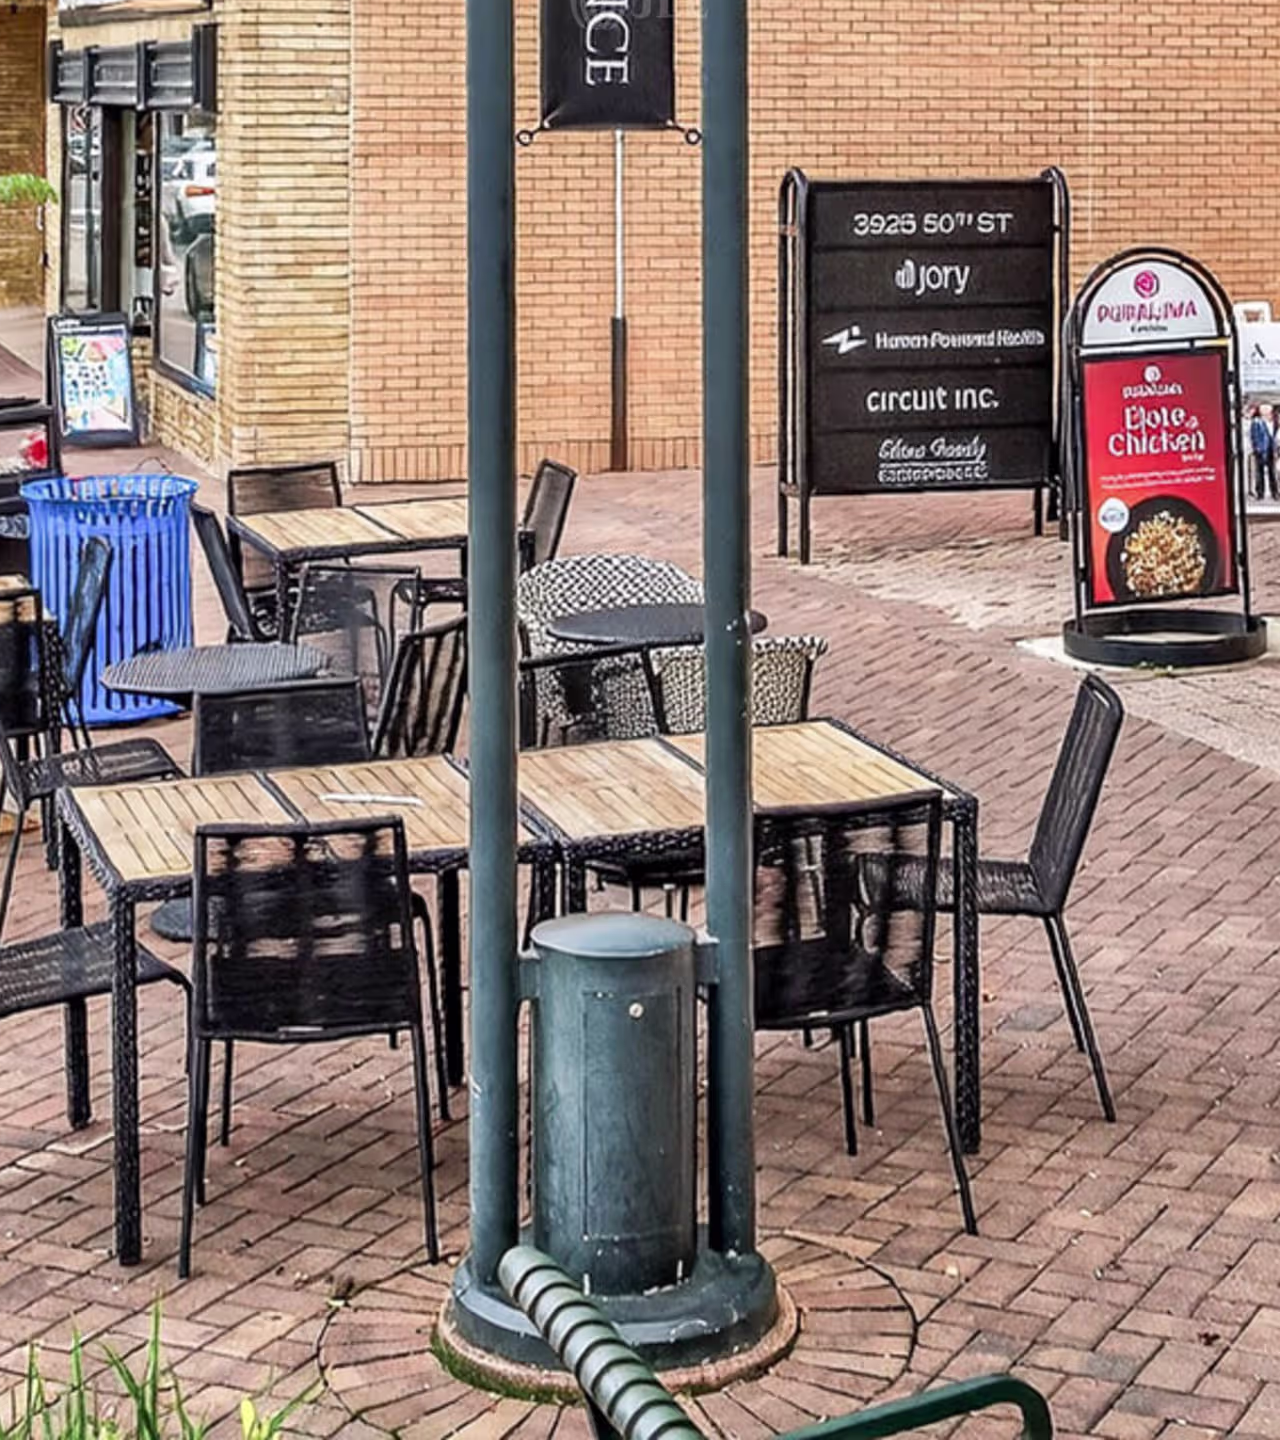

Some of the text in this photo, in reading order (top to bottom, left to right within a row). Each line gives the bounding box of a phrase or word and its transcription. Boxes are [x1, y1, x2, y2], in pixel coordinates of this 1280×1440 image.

[977, 212, 1013, 234] ST
[915, 263, 970, 295] jory
[875, 331, 928, 350] Human
[866, 386, 948, 412] circuit
[1108, 430, 1206, 456] Chicken
